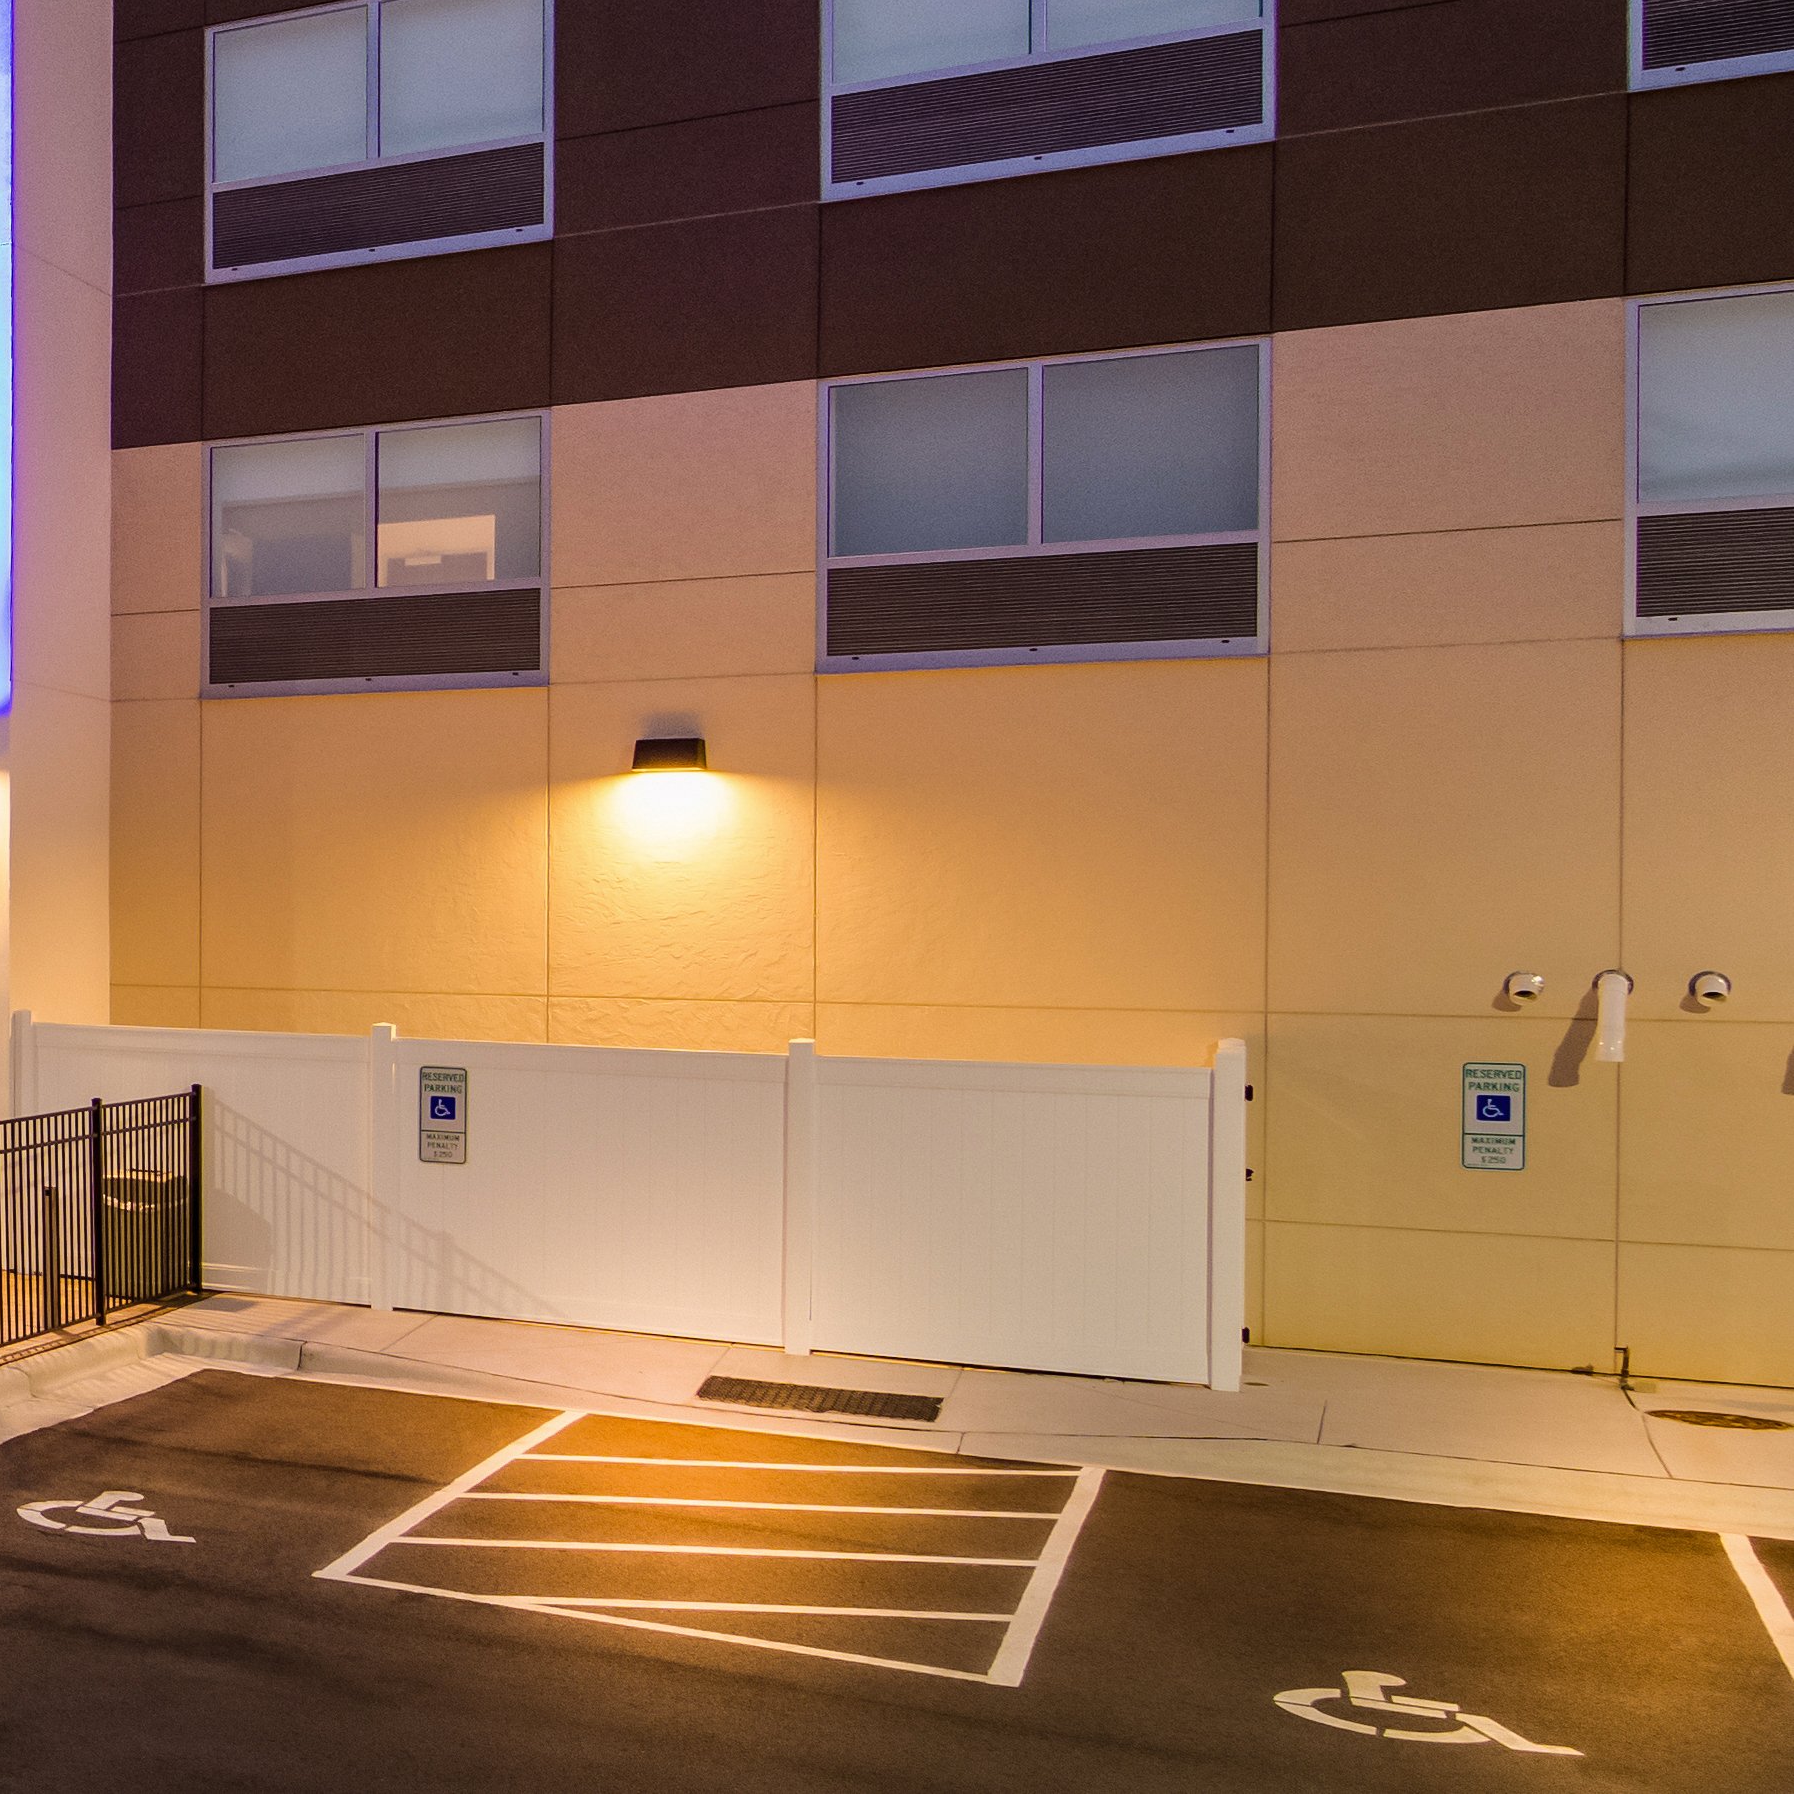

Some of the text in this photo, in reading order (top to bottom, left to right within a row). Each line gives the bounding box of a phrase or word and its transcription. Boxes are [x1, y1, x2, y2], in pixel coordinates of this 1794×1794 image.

[422, 1072, 464, 1082] RESERVED
[1465, 1069, 1522, 1080] RESERVED
[424, 1084, 462, 1094] PARKING
[1468, 1081, 1520, 1092] PARKING
[426, 1134, 460, 1142] MAXIMUM
[1471, 1137, 1516, 1145] MAXIMUM
[427, 1141, 458, 1150] PENALTY
[1472, 1146, 1514, 1155] PENALTY
